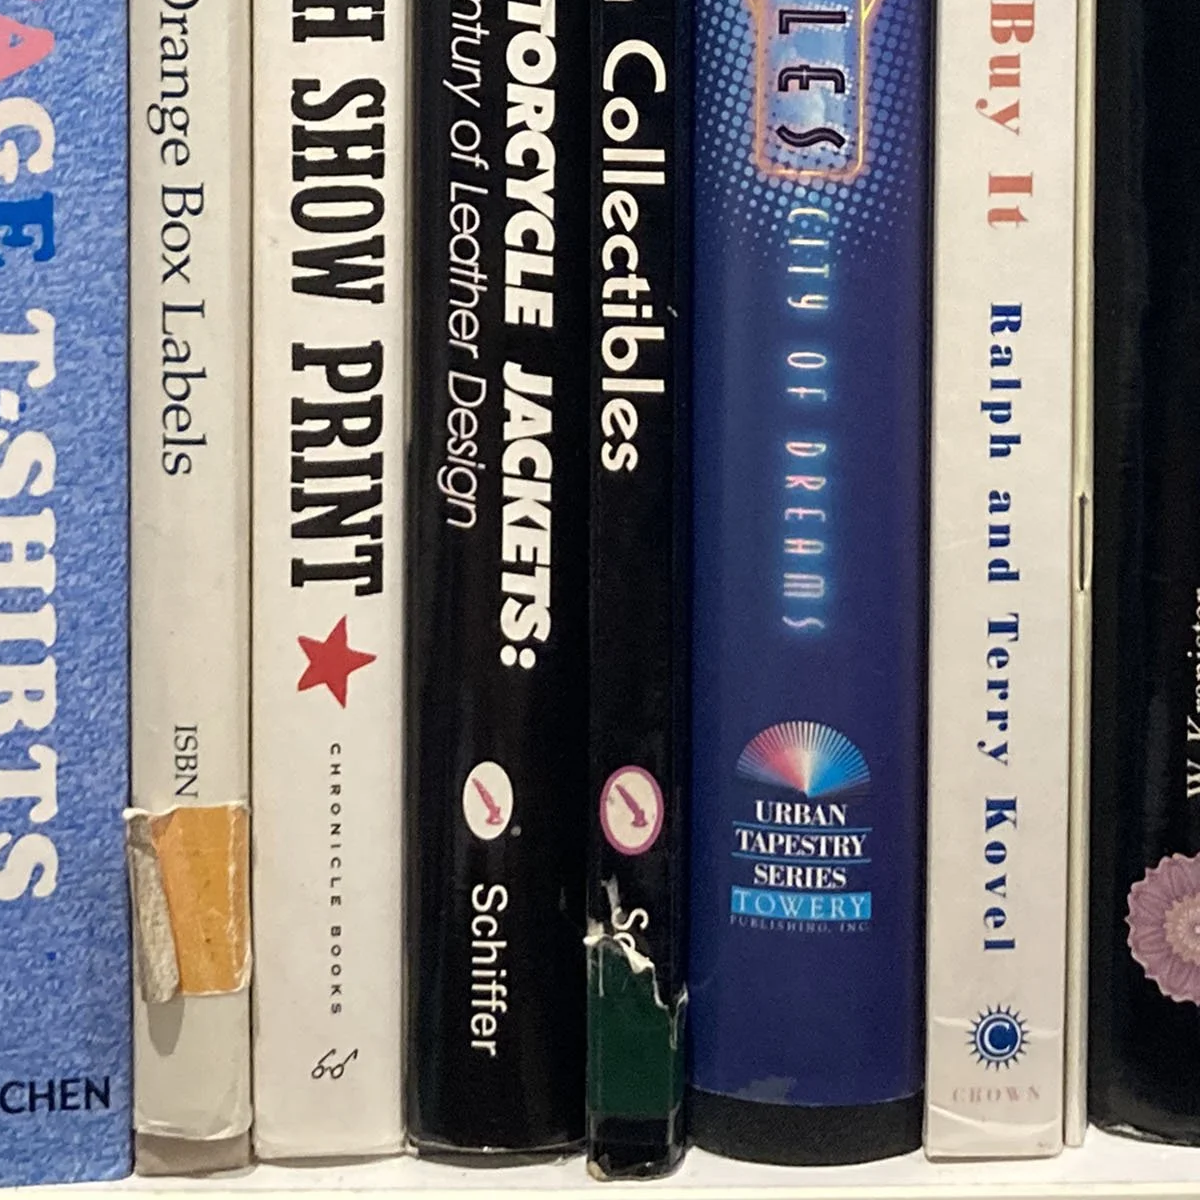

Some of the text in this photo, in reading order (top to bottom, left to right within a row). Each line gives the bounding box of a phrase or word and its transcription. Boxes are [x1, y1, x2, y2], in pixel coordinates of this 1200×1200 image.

[449, 119, 490, 171] of
[974, 0, 1037, 135] Buy
[160, 182, 205, 284] Box
[290, 78, 386, 305] SHOW
[448, 181, 489, 360] Leather
[601, 39, 667, 472] Collectibles
[987, 172, 1033, 227] It
[161, 299, 208, 476] Labels
[436, 370, 487, 529] Design
[783, 206, 829, 632] CITY OF DREAMS
[290, 339, 384, 597] PRINT
[499, 360, 553, 670] JACKETS:
[976, 303, 1023, 951] Ralph and Terry Kovel
[173, 725, 199, 798] ISBN
[756, 800, 848, 827] URBAN
[330, 742, 342, 1015] CHRONICLE BOOKS
[735, 890, 865, 919] TOWERY
[736, 829, 867, 858] TAPESTRY
[754, 864, 846, 889] SERIES
[470, 883, 509, 1057] Schiffer
[953, 1086, 1040, 1105] CROWN
